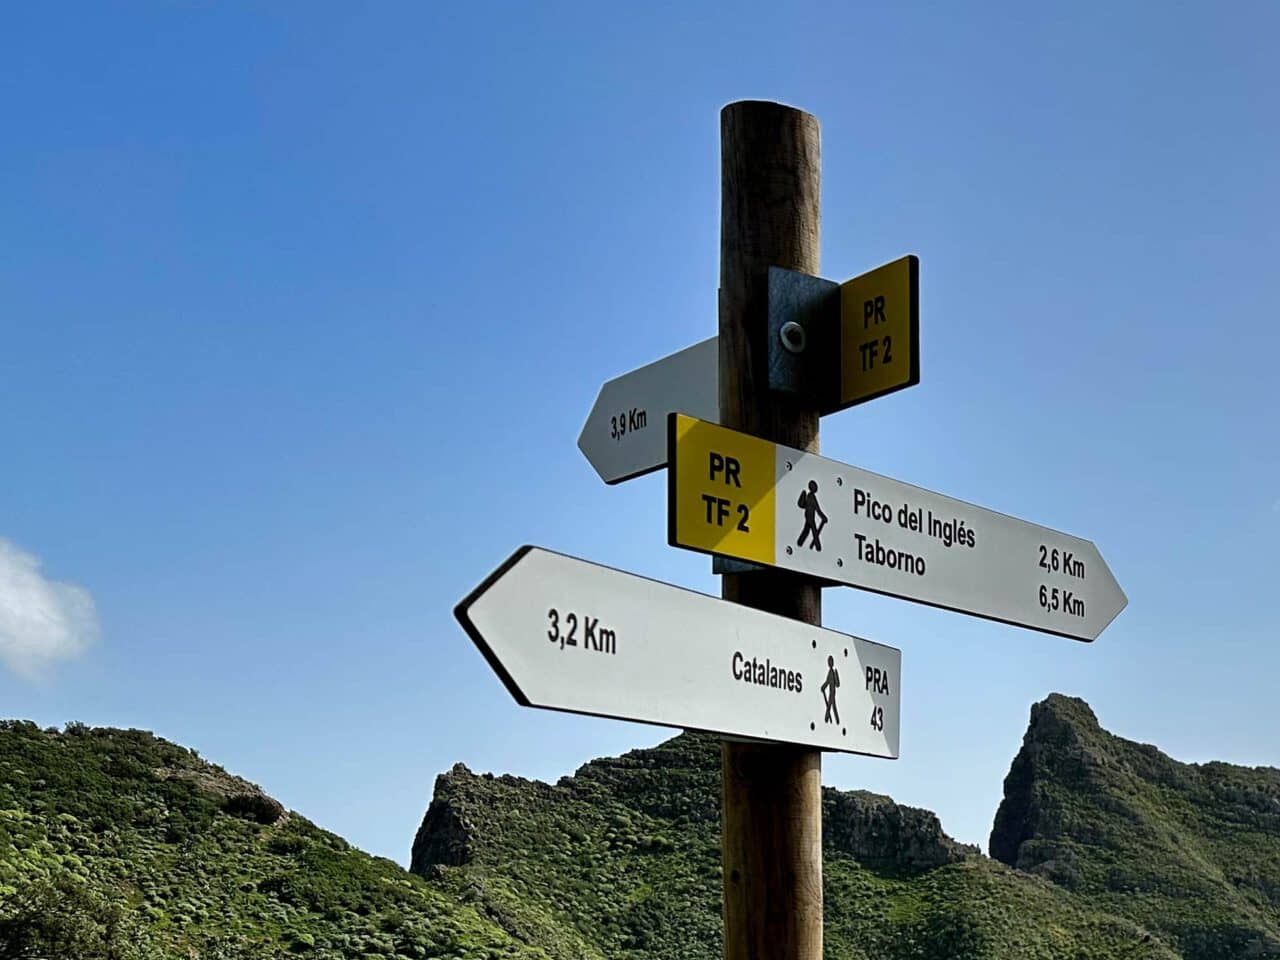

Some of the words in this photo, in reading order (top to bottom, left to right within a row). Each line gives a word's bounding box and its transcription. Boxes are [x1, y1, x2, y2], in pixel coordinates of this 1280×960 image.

[863, 296, 887, 330] PR
[859, 341, 879, 372] TF
[882, 336, 893, 364] 2
[611, 413, 626, 440] 3,9
[628, 408, 647, 433] Km
[709, 452, 742, 488] PR
[702, 494, 731, 526] TF
[737, 503, 750, 533] 2
[853, 489, 893, 524] Pico
[897, 503, 923, 534] del
[927, 511, 976, 548] Inglés
[854, 533, 926, 576] Taborno
[1039, 545, 1060, 574] 2,6
[1063, 552, 1085, 580] Km
[1039, 585, 1060, 613] 6,5
[1063, 591, 1085, 618] Km
[547, 608, 578, 649] 3,2
[584, 616, 616, 655] Km
[732, 652, 803, 693] Catalanes
[865, 666, 890, 695] PRA
[871, 706, 884, 732] 43
